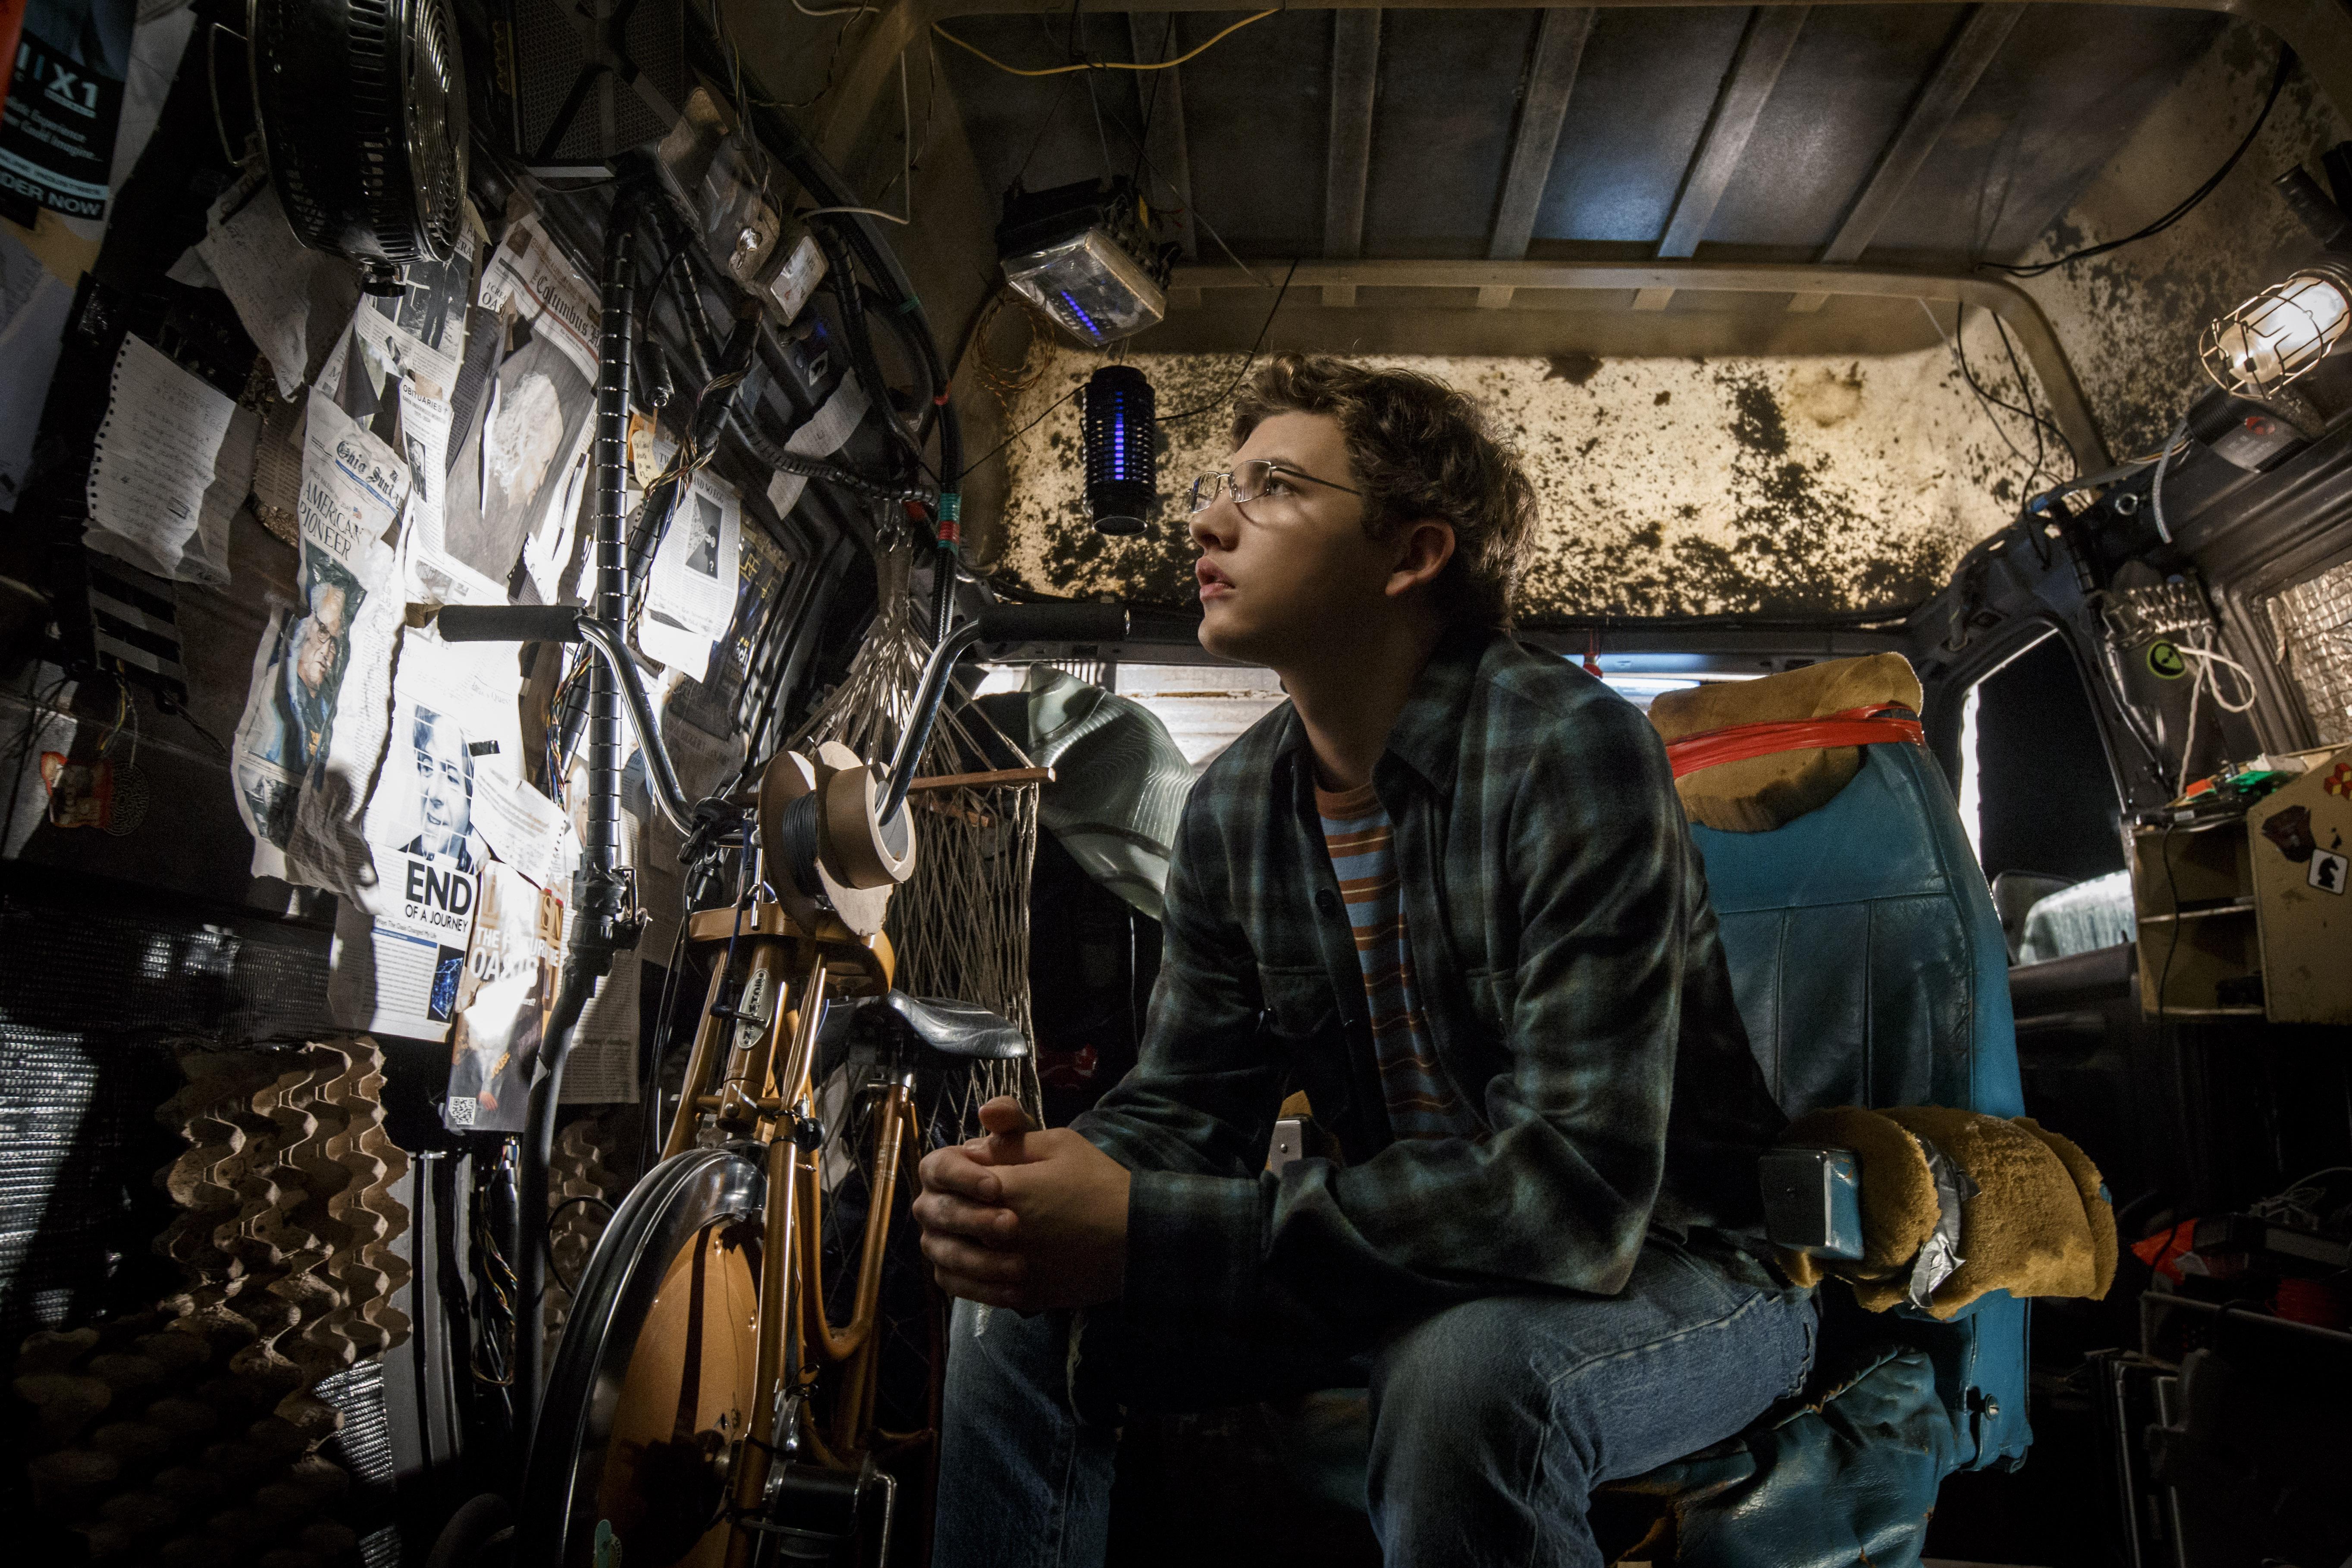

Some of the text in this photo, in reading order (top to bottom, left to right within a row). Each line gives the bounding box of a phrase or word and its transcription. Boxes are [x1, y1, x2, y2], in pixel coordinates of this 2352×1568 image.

[47, 192, 102, 216] NOW
[536, 275, 588, 336] Columbus
[403, 384, 442, 413] OBITUARIES
[336, 440, 367, 474] Ohio
[303, 480, 364, 545] AMERICAN
[299, 499, 352, 561] PIONEER
[406, 859, 472, 916] END
[405, 904, 469, 933] OF A JOURNEY
[474, 927, 501, 948] THE
